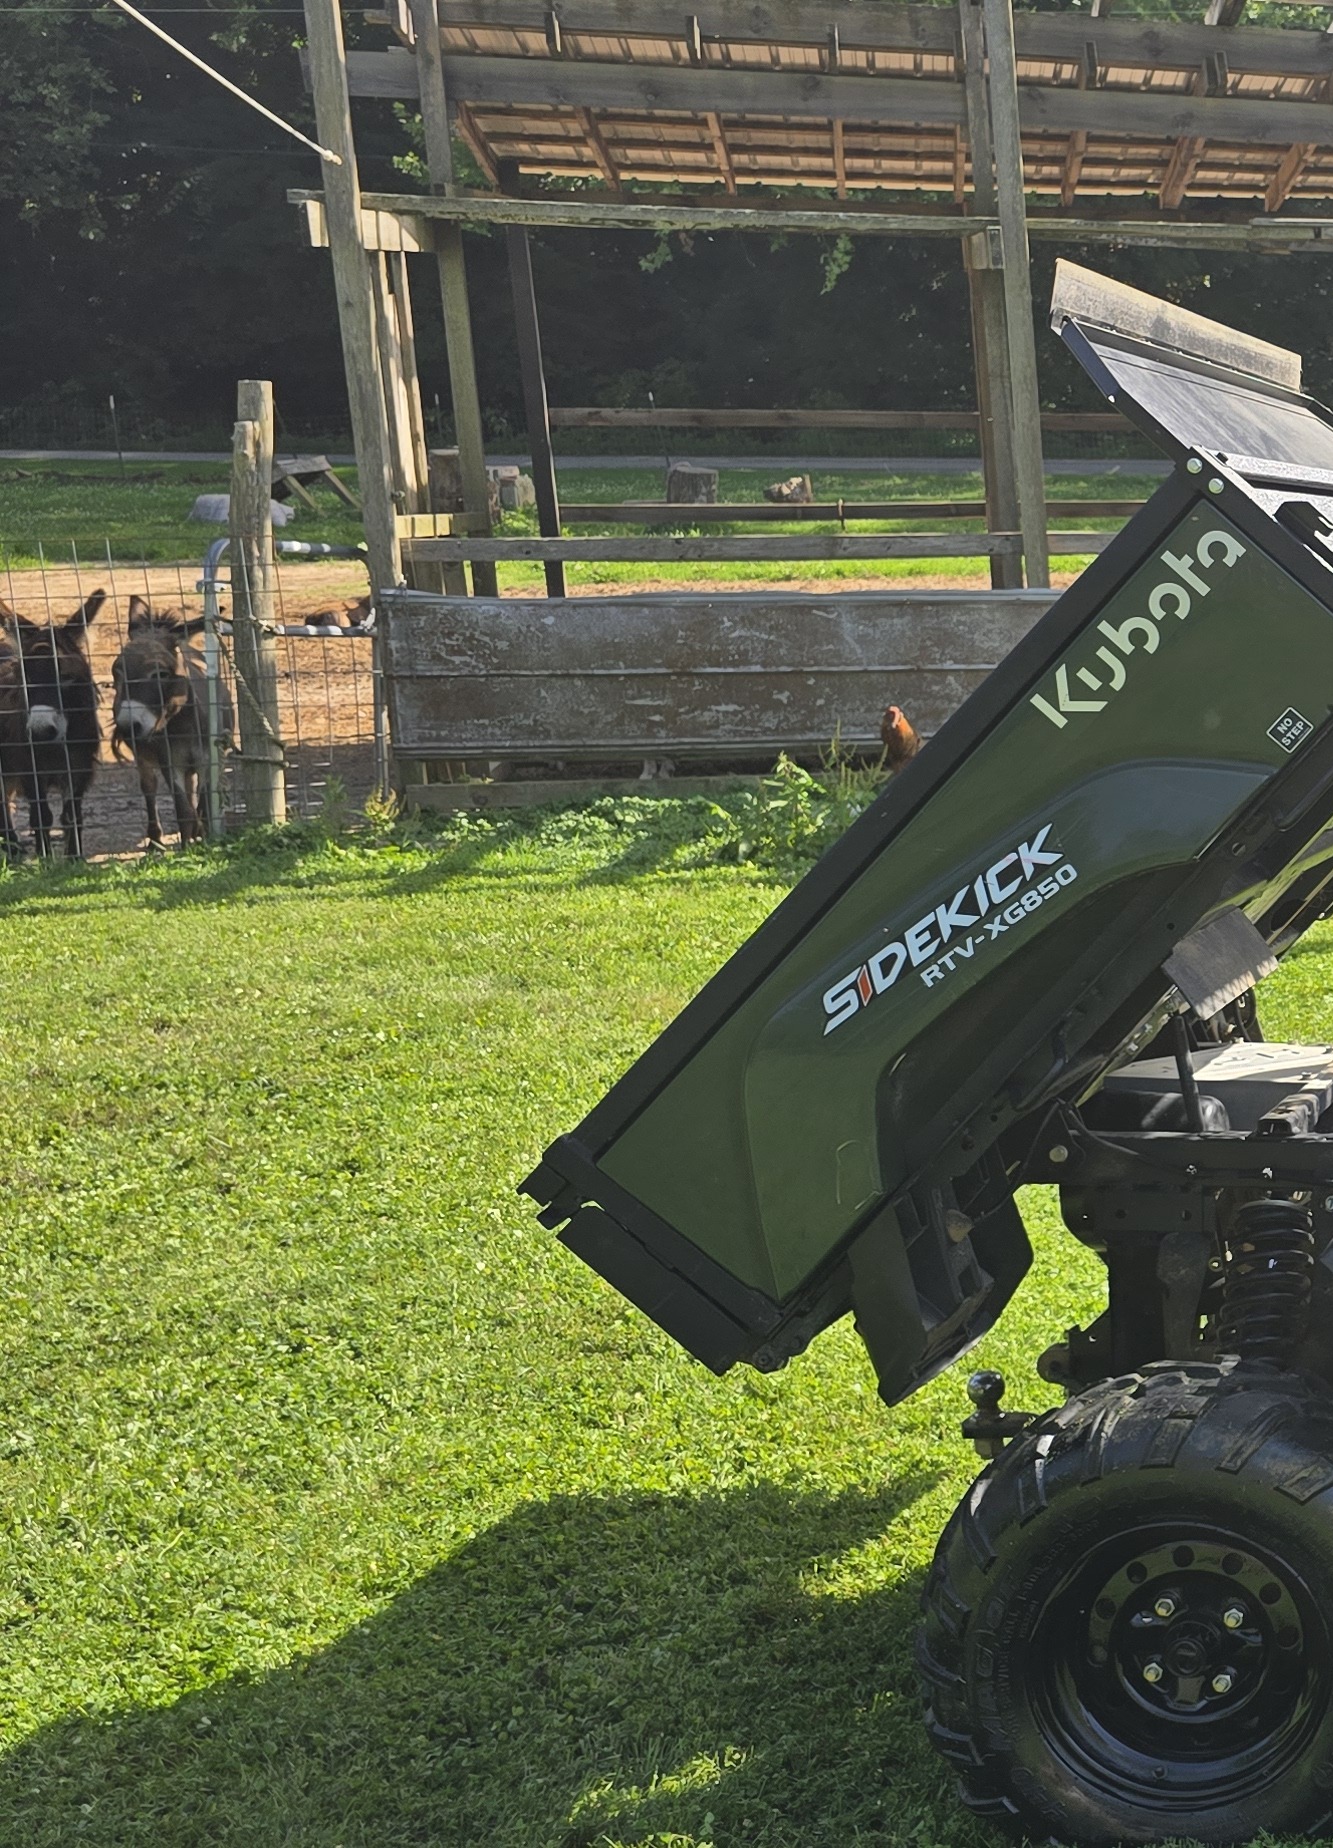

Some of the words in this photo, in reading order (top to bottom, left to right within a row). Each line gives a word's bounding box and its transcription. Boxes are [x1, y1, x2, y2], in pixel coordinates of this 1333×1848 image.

[1030, 530, 1246, 729] Kubota
[1277, 718, 1293, 734] NO
[1281, 721, 1304, 746] STEP
[823, 823, 1064, 1036] SIDEKICK
[920, 863, 1078, 988] RTV-XG850
